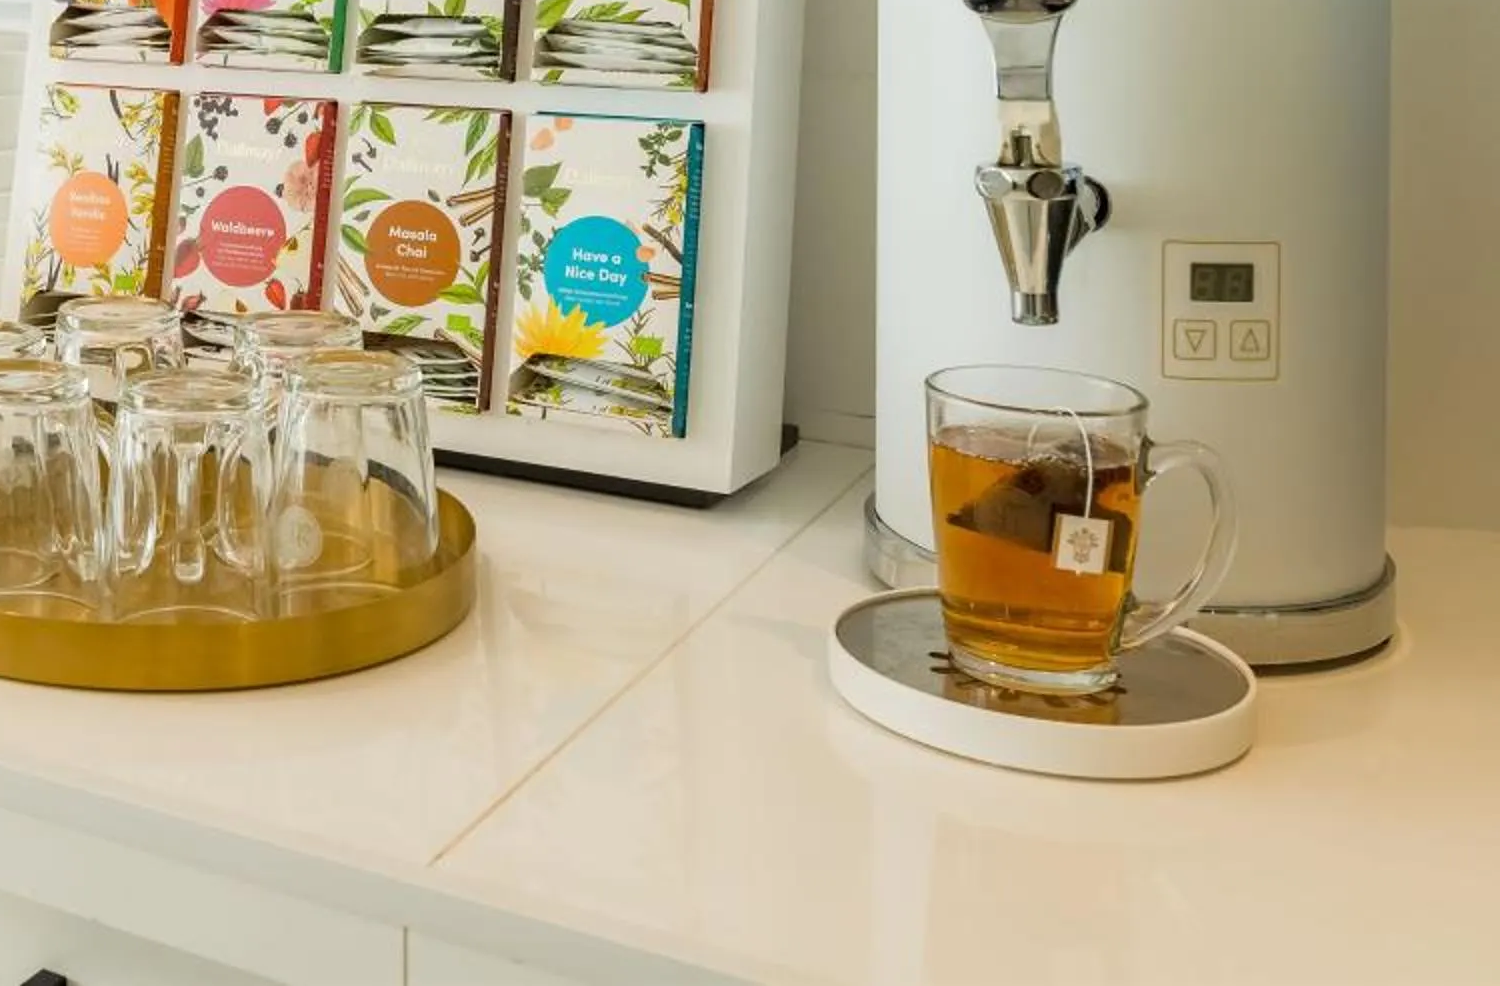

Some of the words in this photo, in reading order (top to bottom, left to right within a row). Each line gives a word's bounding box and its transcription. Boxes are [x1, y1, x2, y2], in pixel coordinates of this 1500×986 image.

[211, 219, 276, 238] Waldbeere
[388, 225, 438, 242] Masala
[396, 243, 428, 259] Chai
[572, 247, 609, 264] Have
[611, 254, 622, 266] a
[565, 265, 596, 281] Nice
[599, 268, 627, 287] Day
